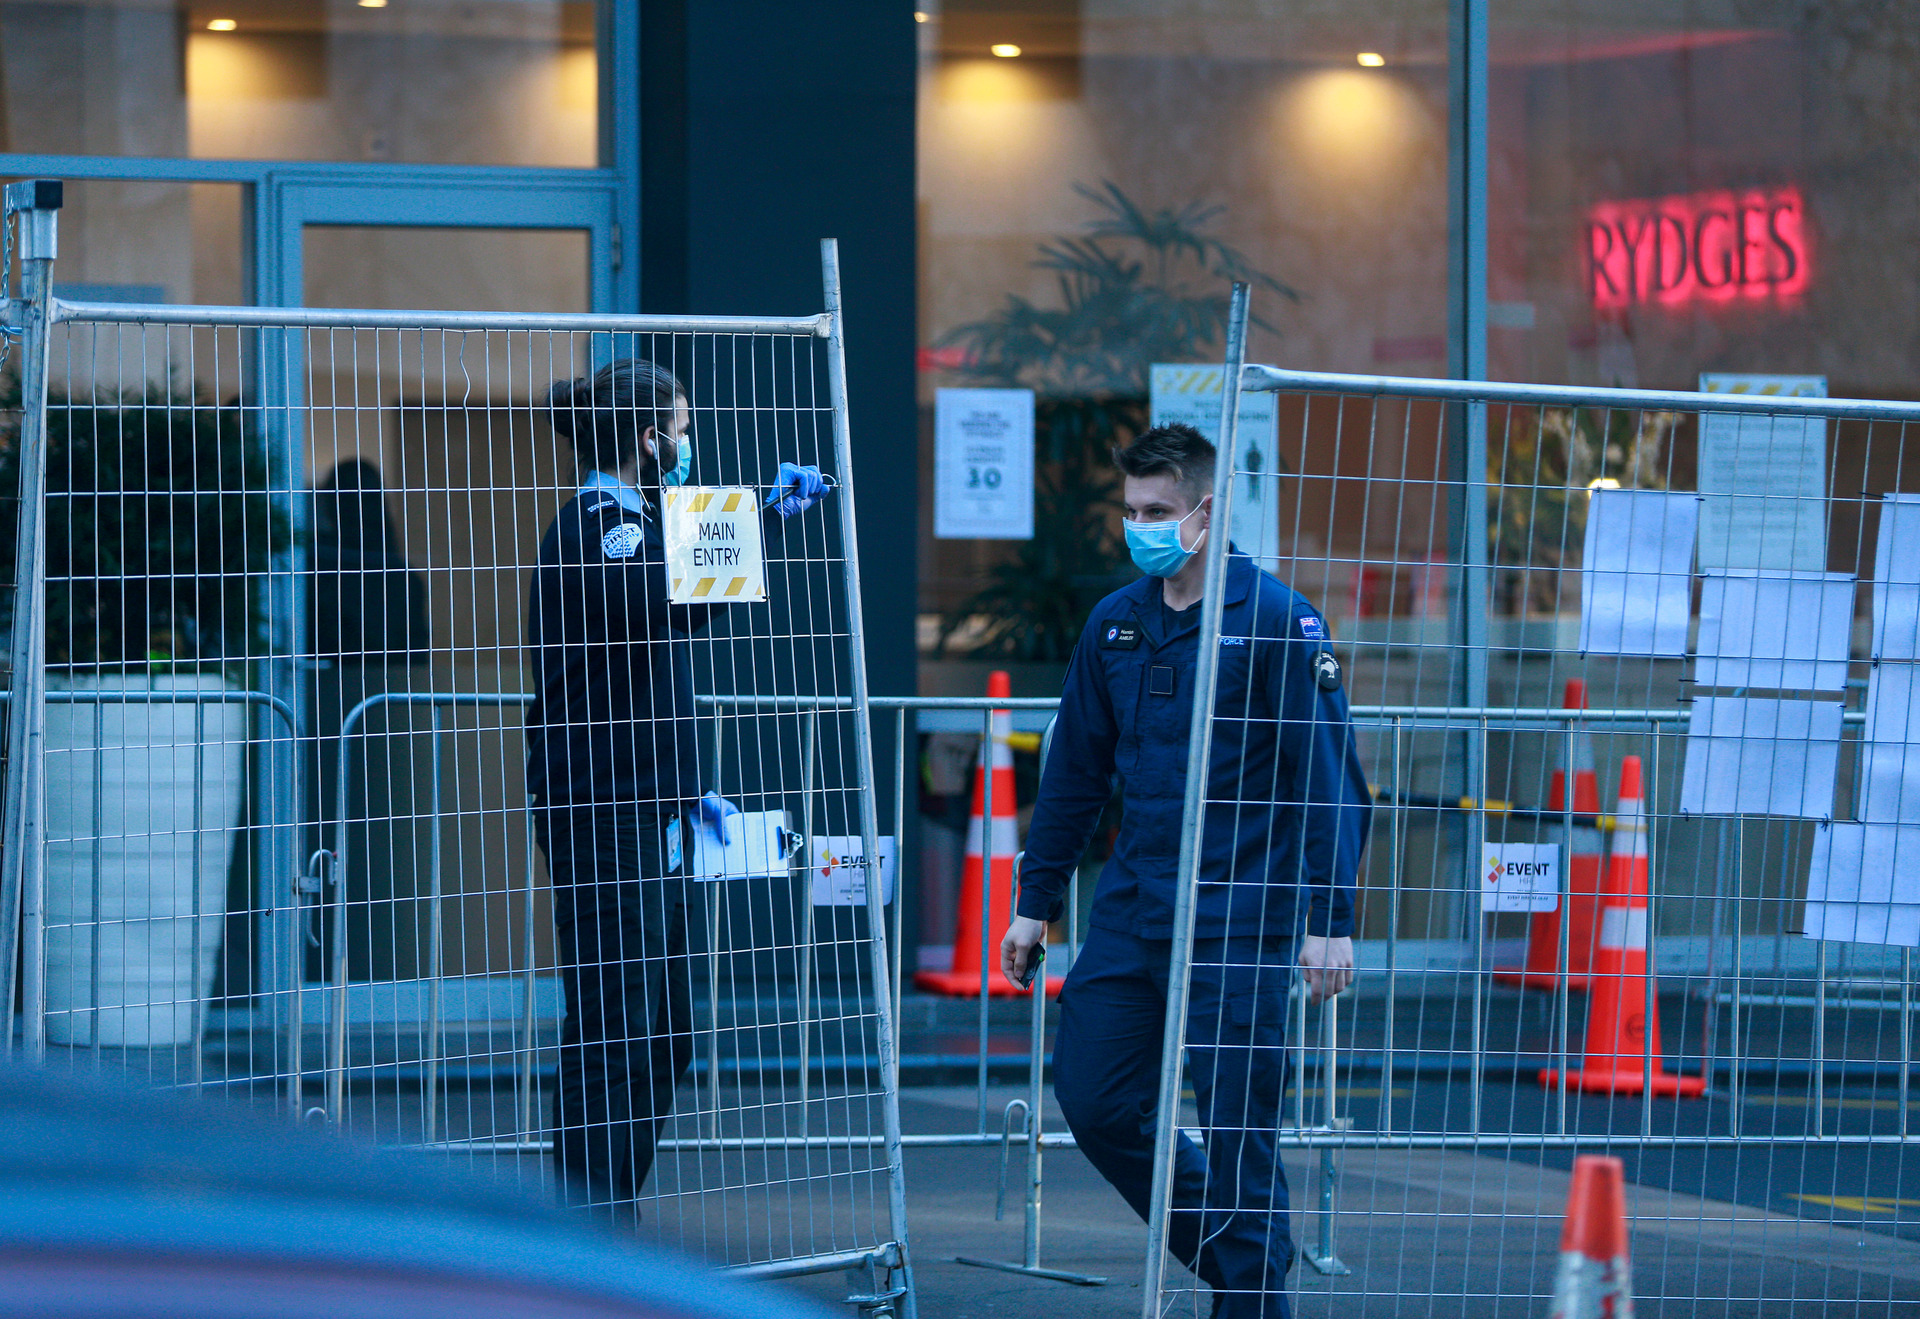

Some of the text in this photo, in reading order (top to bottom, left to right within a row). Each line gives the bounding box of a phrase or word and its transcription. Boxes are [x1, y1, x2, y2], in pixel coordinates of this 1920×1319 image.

[1586, 205, 1796, 298] RYDGES
[604, 526, 636, 550] FIRST
[698, 522, 735, 541] MAIN
[693, 547, 741, 567] ENTRY
[1219, 637, 1245, 646] FORCE
[841, 856, 886, 869] EVET
[1507, 862, 1550, 876] EVENT
